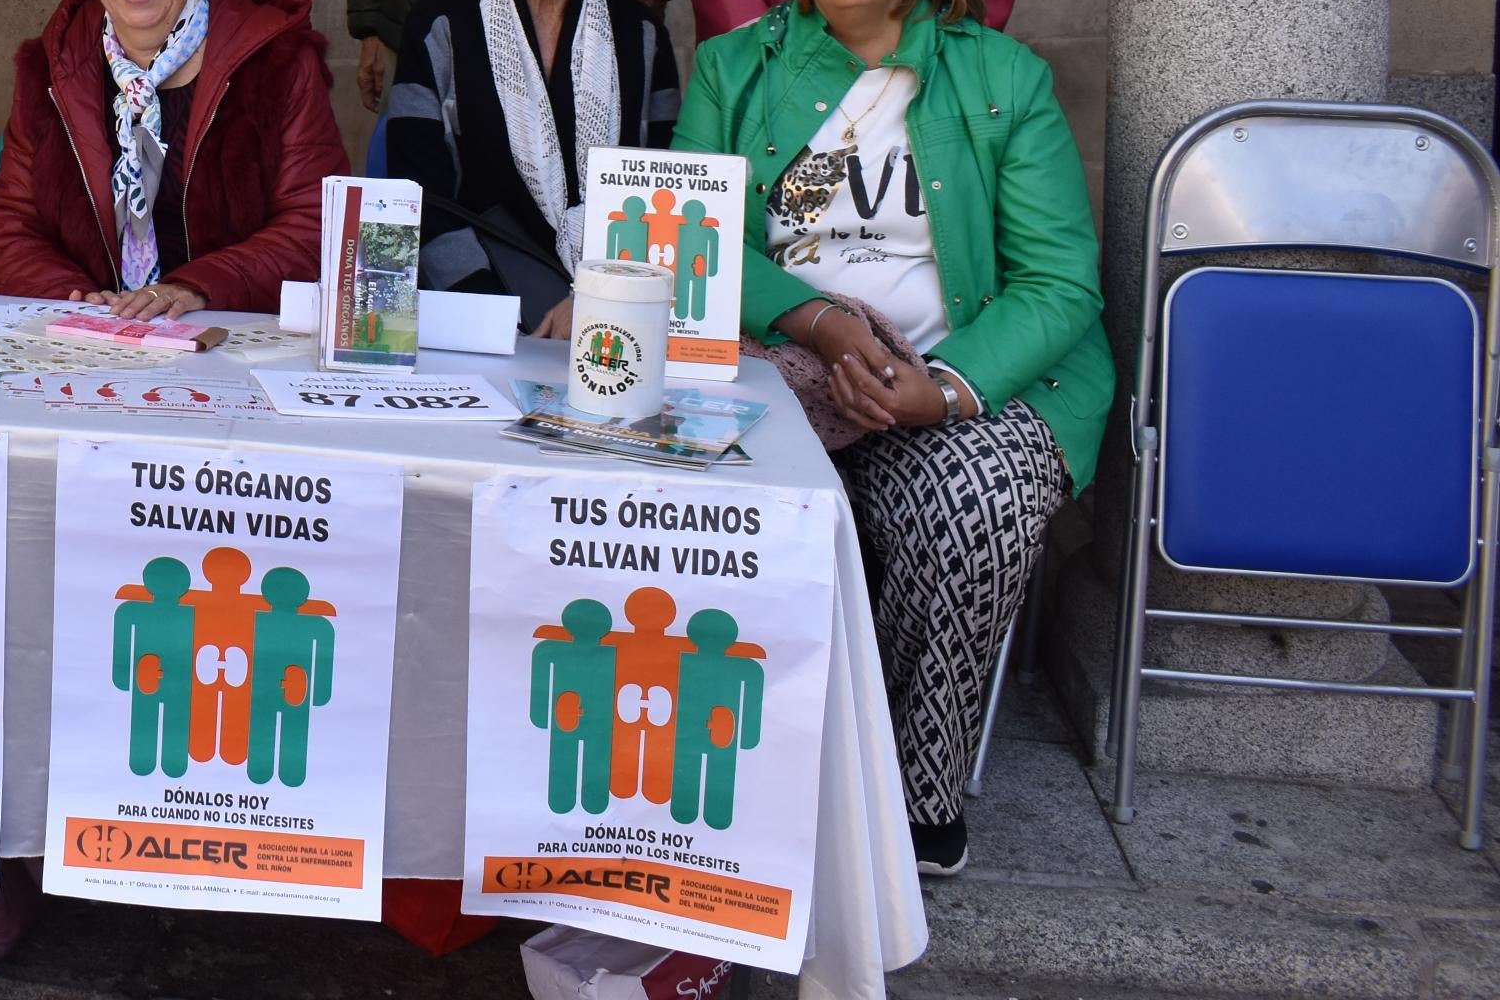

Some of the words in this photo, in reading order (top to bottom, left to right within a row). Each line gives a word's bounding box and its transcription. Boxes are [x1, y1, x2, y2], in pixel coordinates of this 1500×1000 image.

[621, 159, 645, 173] TUS
[650, 160, 708, 176] RIÑONES
[600, 173, 650, 187] SALVAN
[655, 176, 682, 190] DOS
[688, 178, 728, 192] VIDAS
[344, 239, 355, 271] DONA
[847, 253, 891, 264] heart
[342, 273, 352, 291] TUS
[669, 320, 686, 329] HOY
[610, 325, 635, 342] SALVAN
[633, 342, 642, 362] VIDAS
[582, 352, 629, 372] ALCER
[289, 383, 363, 391] LOTERÍA
[298, 392, 489, 410] 87.082
[573, 429, 658, 449] Mundial
[131, 462, 185, 491] TUS
[195, 461, 332, 504] ÓRGANOS
[130, 502, 235, 534] SALVAN
[246, 512, 329, 542] VIDAS
[551, 496, 607, 526] TUS
[618, 493, 760, 536] ÓRGANOS
[550, 538, 660, 572] SALVAN
[671, 547, 759, 579] VIDAS
[164, 786, 234, 809] DÓNALOS
[238, 794, 270, 811] HOY
[117, 804, 148, 817] PARA
[151, 806, 200, 821] CUANDO
[204, 810, 221, 823] NO
[224, 812, 247, 825] LOS
[250, 814, 314, 830] NECESITES
[584, 823, 656, 844] DÓNALOS
[661, 832, 694, 850] HOY
[136, 836, 248, 870] ALCER
[257, 843, 298, 853] ASOCIACIÓN
[300, 846, 317, 854] PARA
[331, 849, 353, 857] LUCHA
[537, 842, 568, 853] PARA
[571, 842, 622, 854] CUANDO
[625, 844, 643, 856] NO
[647, 846, 670, 860] LOS
[673, 852, 740, 874] NECESITES
[256, 863, 269, 871] DEL
[257, 854, 285, 862] CONTRA
[300, 857, 353, 868] ENFERMEDADES
[191, 885, 230, 894] SALAMANCA
[556, 869, 670, 904] ALCER
[680, 879, 723, 893] ASOCIACIÓN
[724, 887, 743, 898] PARA
[745, 891, 754, 900] LA
[756, 894, 780, 906] LUCHA
[679, 899, 691, 907] DEL
[680, 889, 708, 901] CONTRA
[710, 895, 723, 904] LAS
[724, 898, 778, 916] ENFERMEDADES
[611, 909, 651, 926] SALAMANCA
